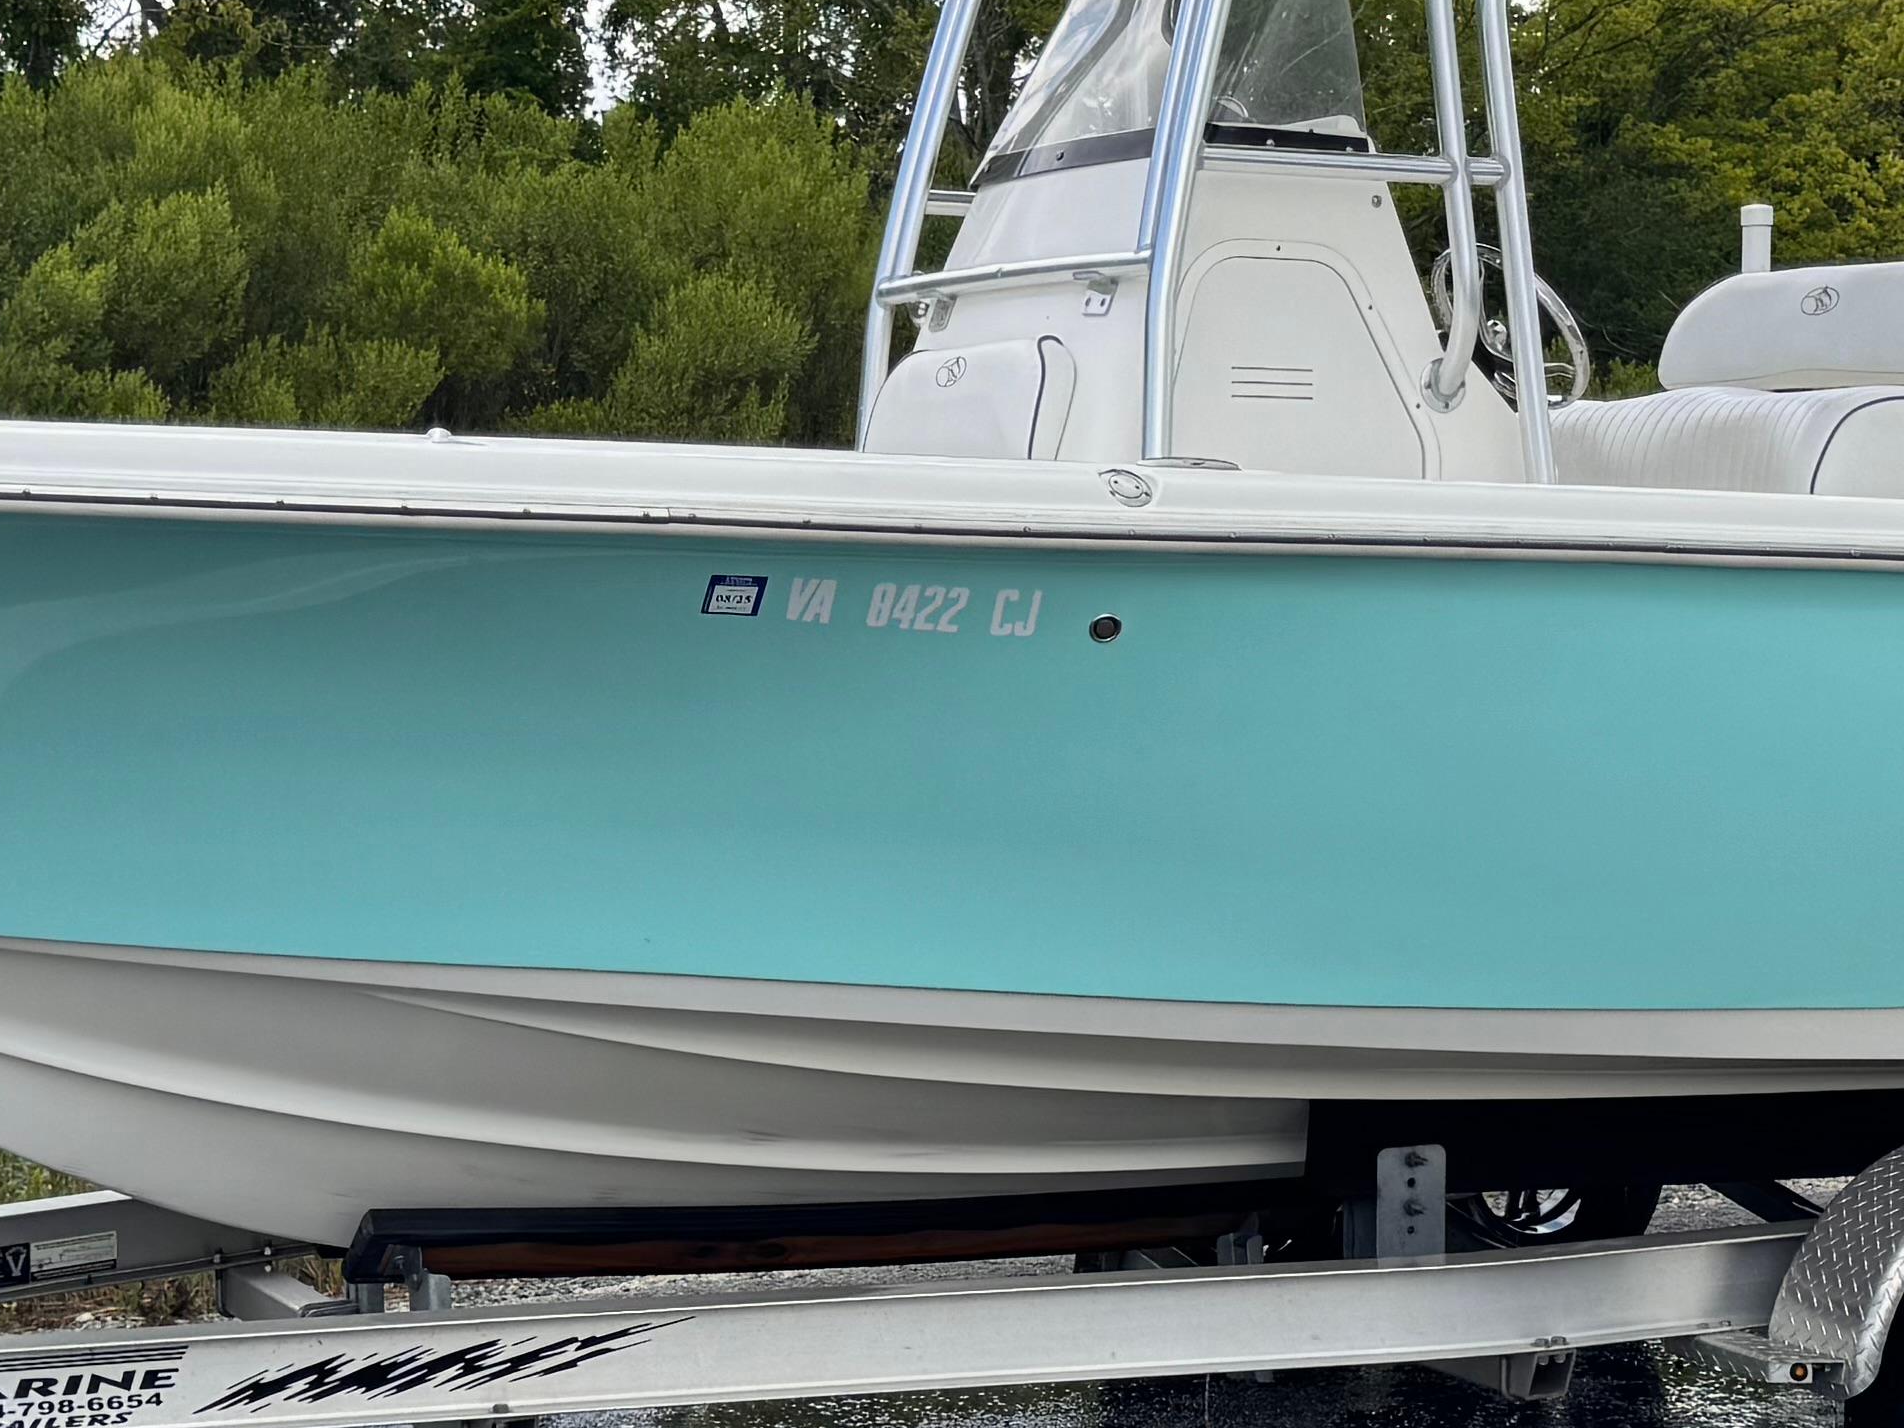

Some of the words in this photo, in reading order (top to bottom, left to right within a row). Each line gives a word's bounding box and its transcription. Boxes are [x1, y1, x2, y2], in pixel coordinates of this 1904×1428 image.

[785, 578, 838, 625] VA
[866, 583, 970, 633] 8422
[989, 590, 1042, 637] CJ
